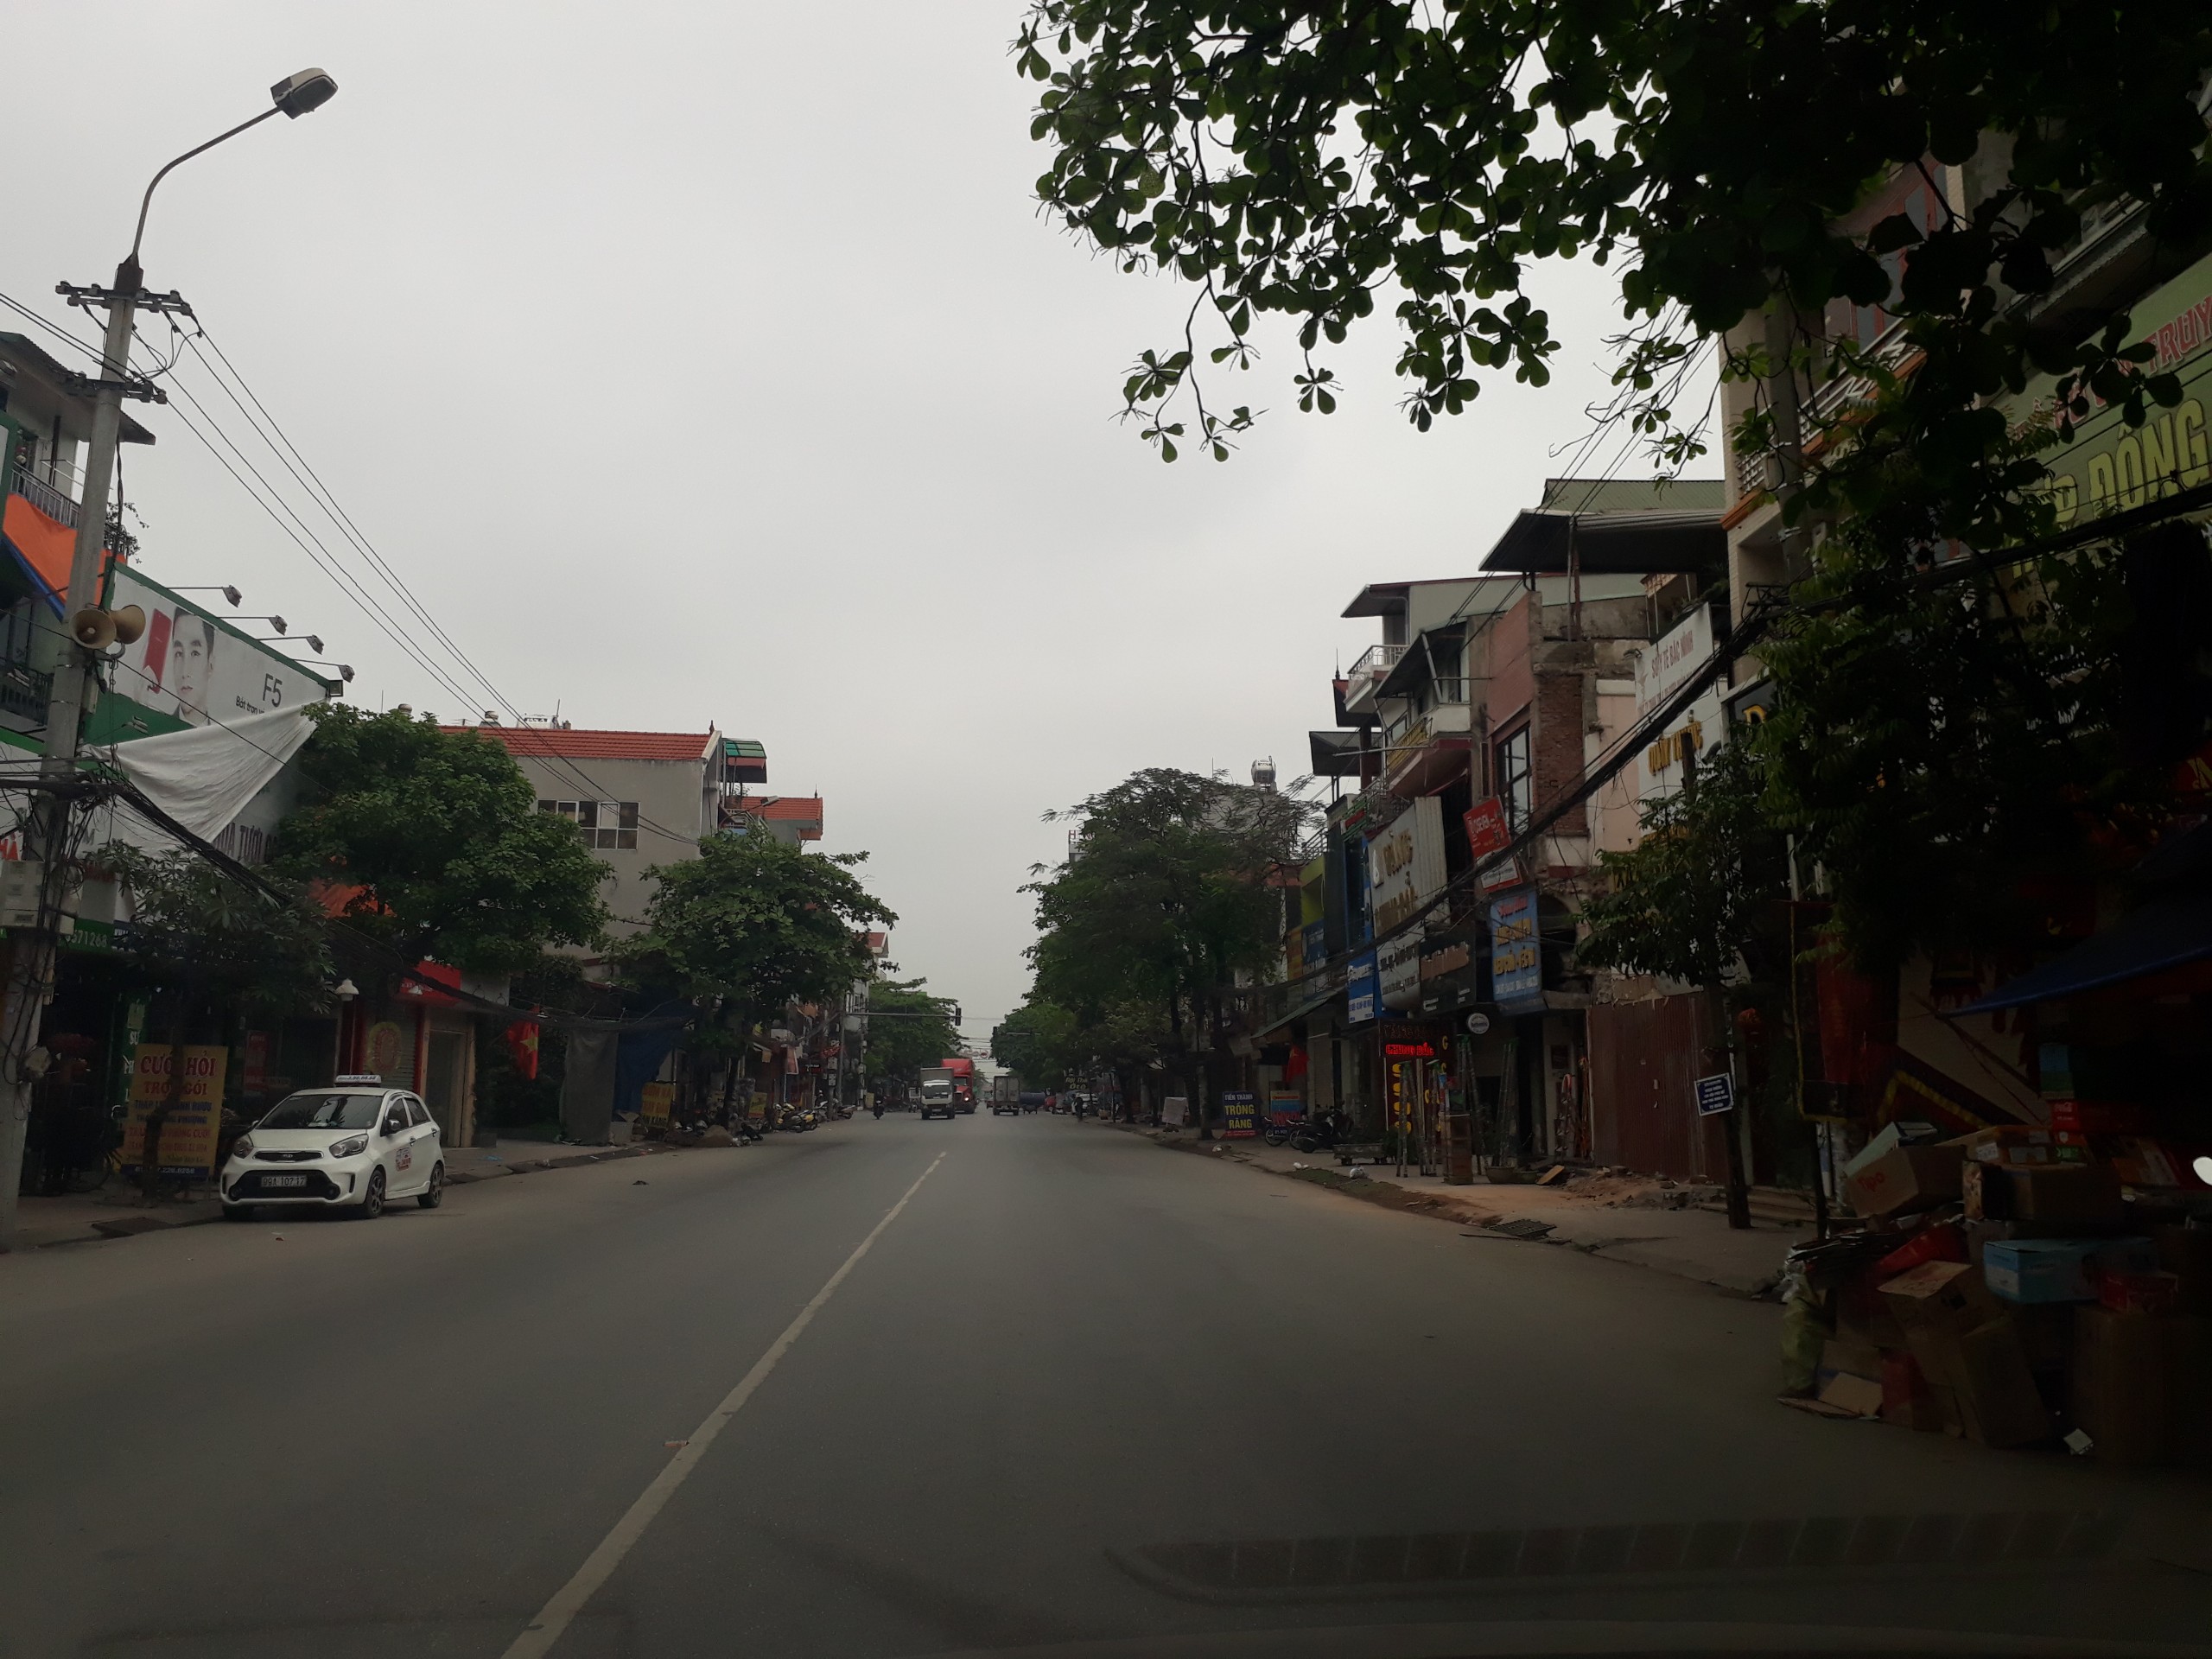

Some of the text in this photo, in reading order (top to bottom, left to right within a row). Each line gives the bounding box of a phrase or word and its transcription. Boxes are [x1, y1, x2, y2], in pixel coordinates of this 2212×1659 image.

[263, 673, 283, 707] F5
[140, 1051, 173, 1076] CƯỚ
[185, 1050, 217, 1077] HỎI
